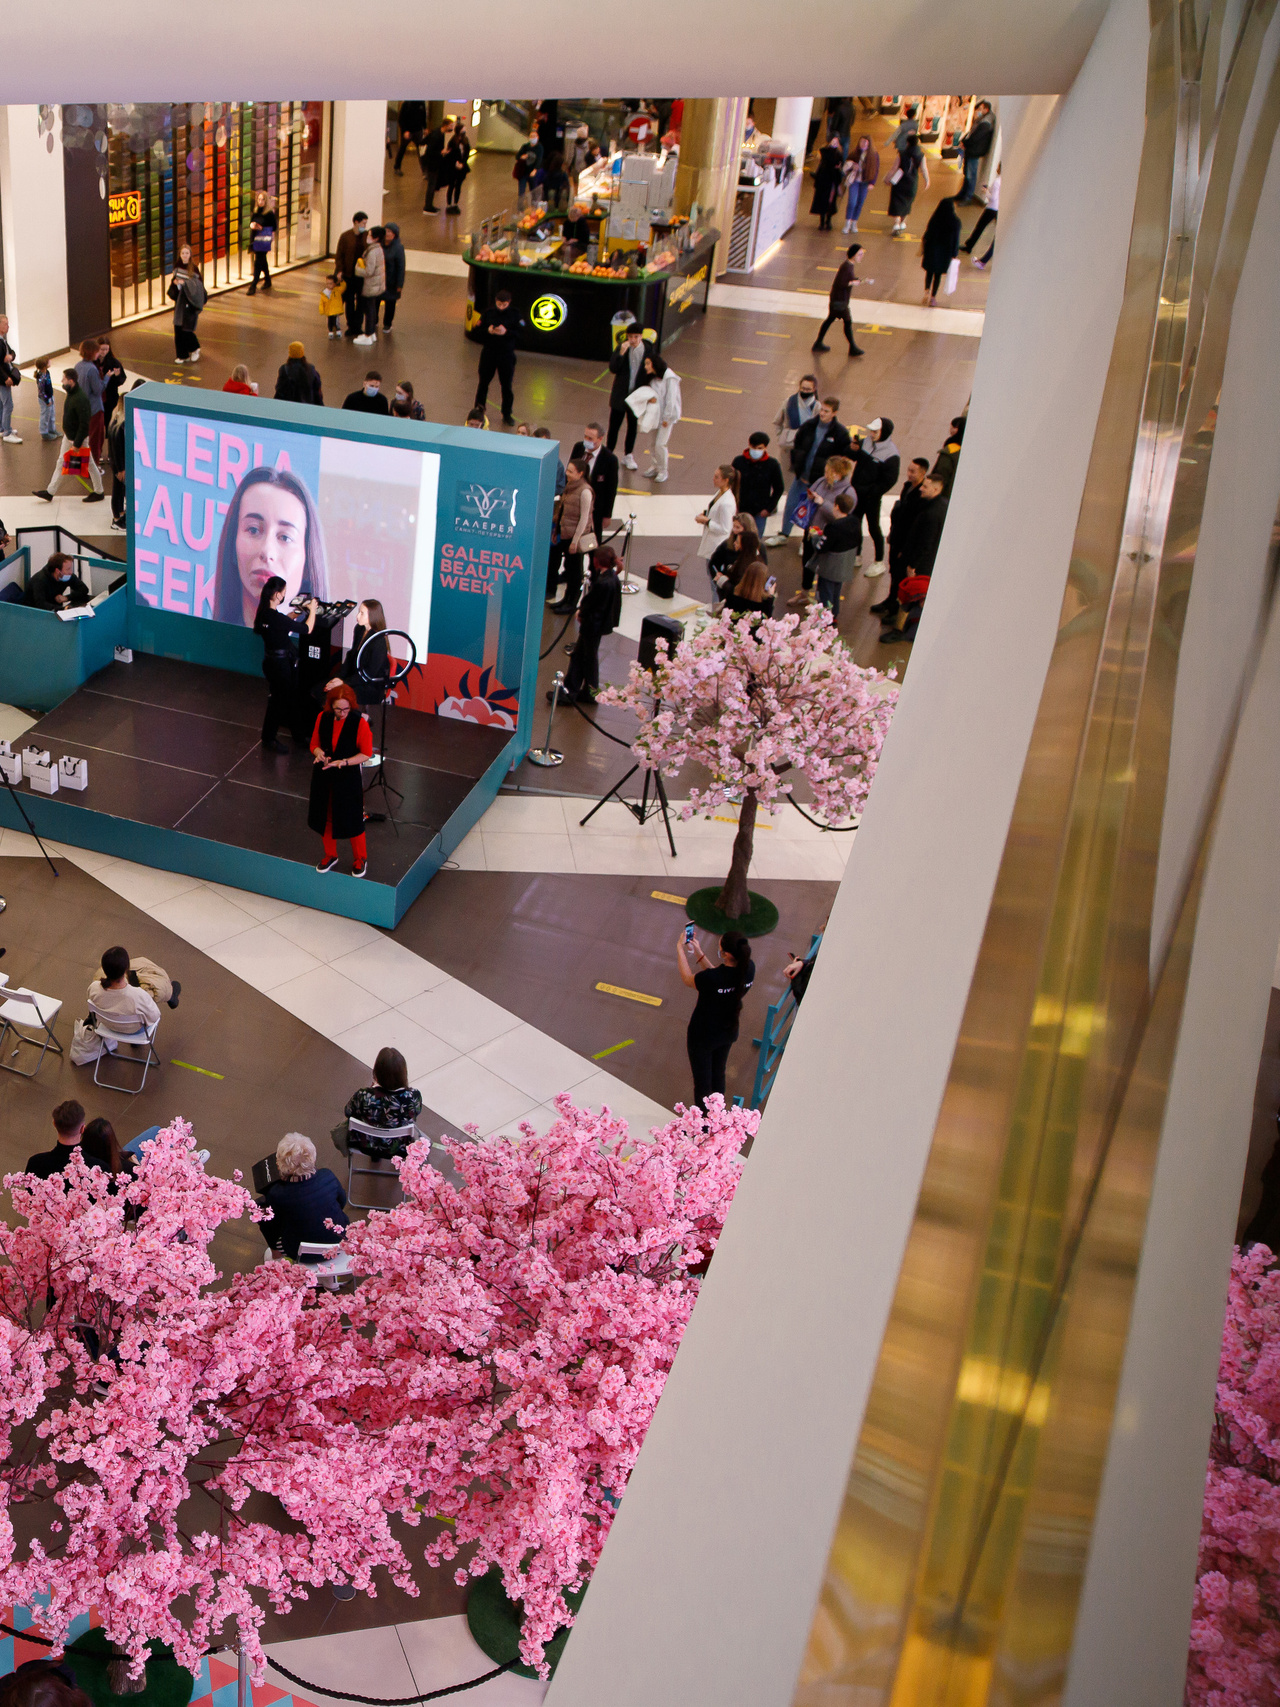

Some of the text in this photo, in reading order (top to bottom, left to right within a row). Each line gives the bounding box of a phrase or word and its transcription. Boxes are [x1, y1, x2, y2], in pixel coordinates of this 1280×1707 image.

[455, 517, 514, 534] ГАЛЕРЕЯ
[441, 543, 524, 570] GALERIA
[440, 558, 516, 584] BEAUTY
[440, 573, 495, 596] WEEK
